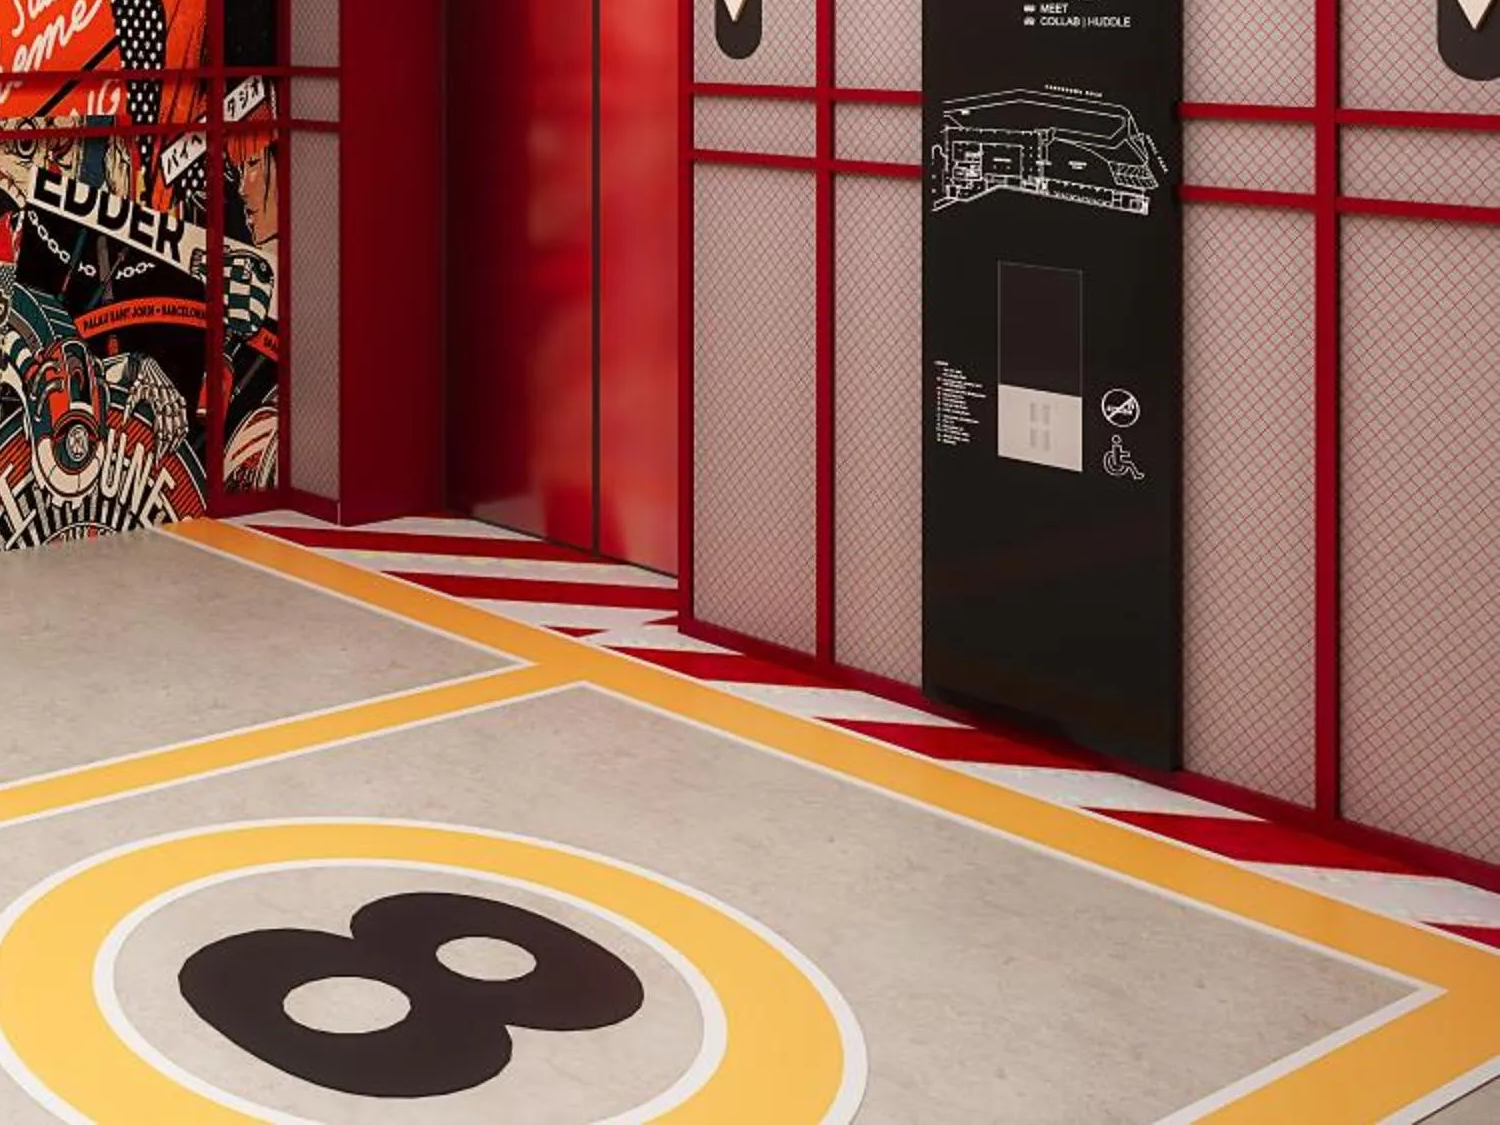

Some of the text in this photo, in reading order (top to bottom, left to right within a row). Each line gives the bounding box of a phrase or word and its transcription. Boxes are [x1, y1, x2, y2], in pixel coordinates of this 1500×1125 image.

[1040, 2, 1069, 14] MEET
[1040, 16, 1081, 27] COLLAB
[1087, 16, 1131, 28] HUDDLE
[178, 891, 645, 1099] 8
